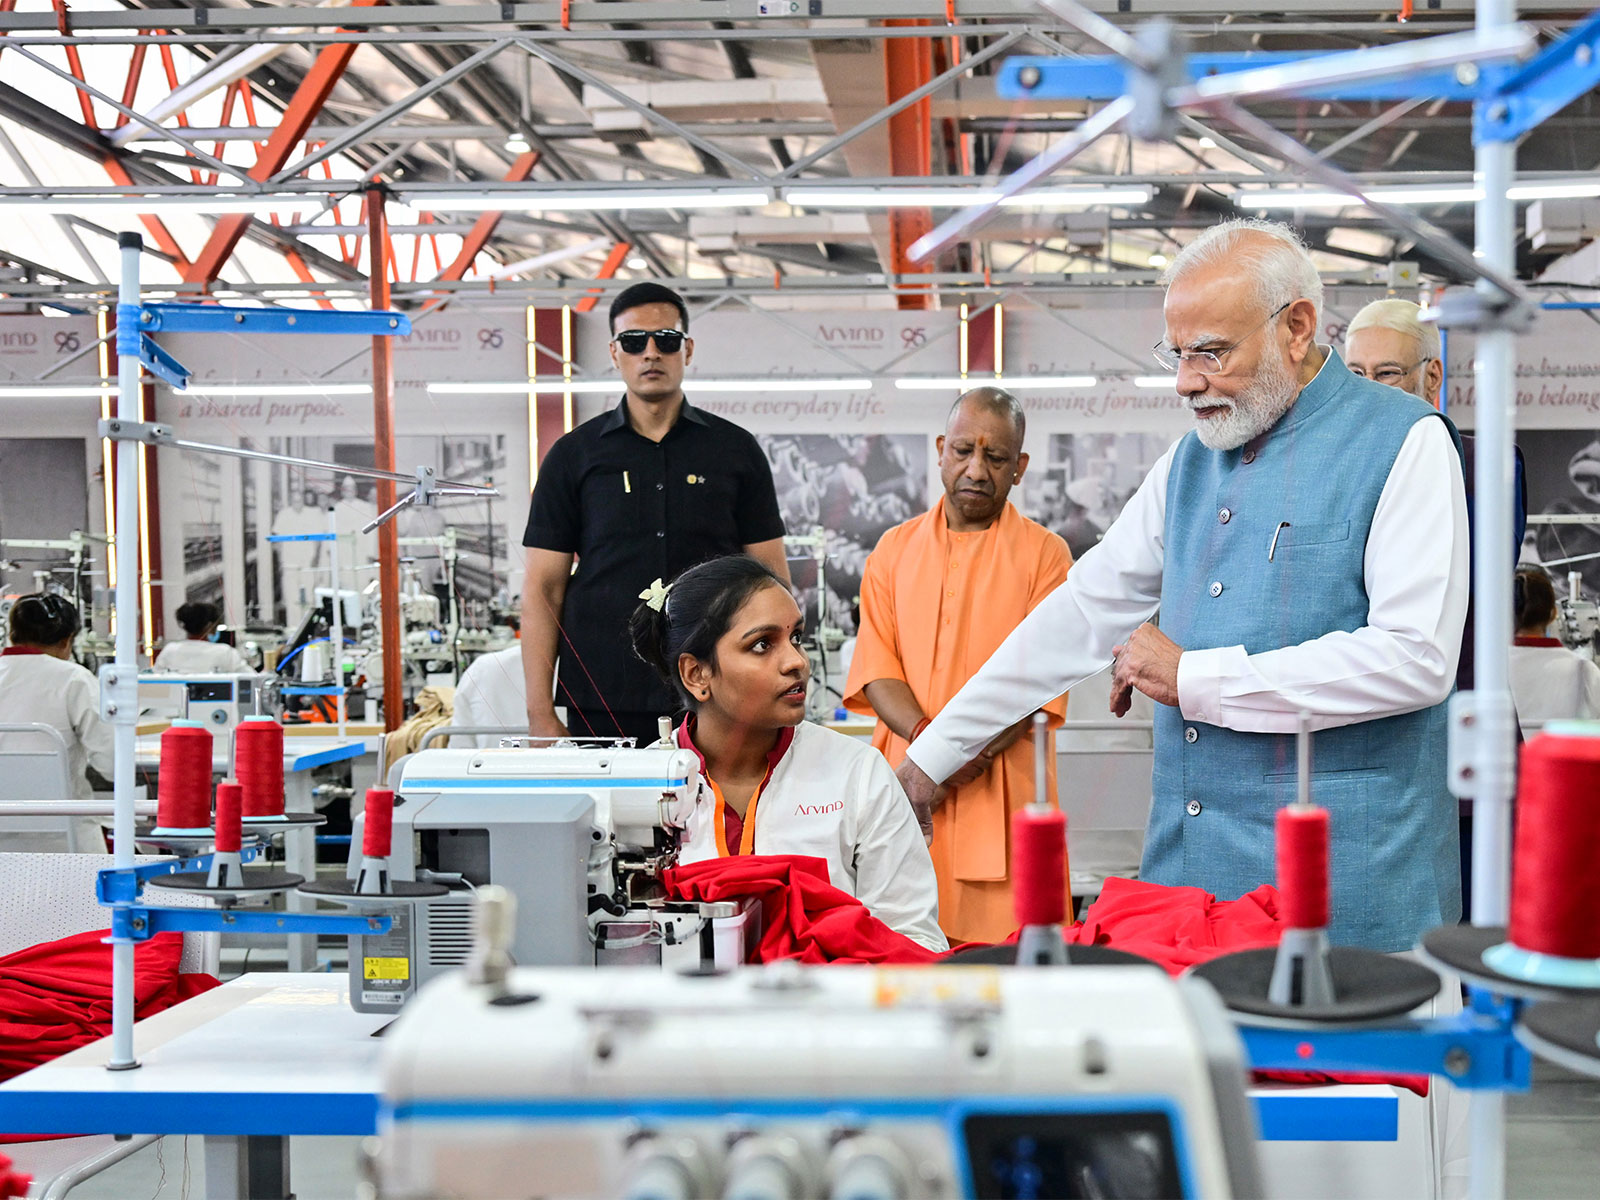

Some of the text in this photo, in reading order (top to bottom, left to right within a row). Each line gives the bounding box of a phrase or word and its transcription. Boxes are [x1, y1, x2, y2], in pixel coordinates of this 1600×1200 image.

[477, 328, 504, 349] 95
[901, 328, 927, 349] 95
[179, 398, 345, 424] a shared purpose.
[752, 394, 841, 421] everyday
[846, 393, 886, 421] life.
[1024, 392, 1097, 416] moving
[1516, 384, 1600, 413] to belong
